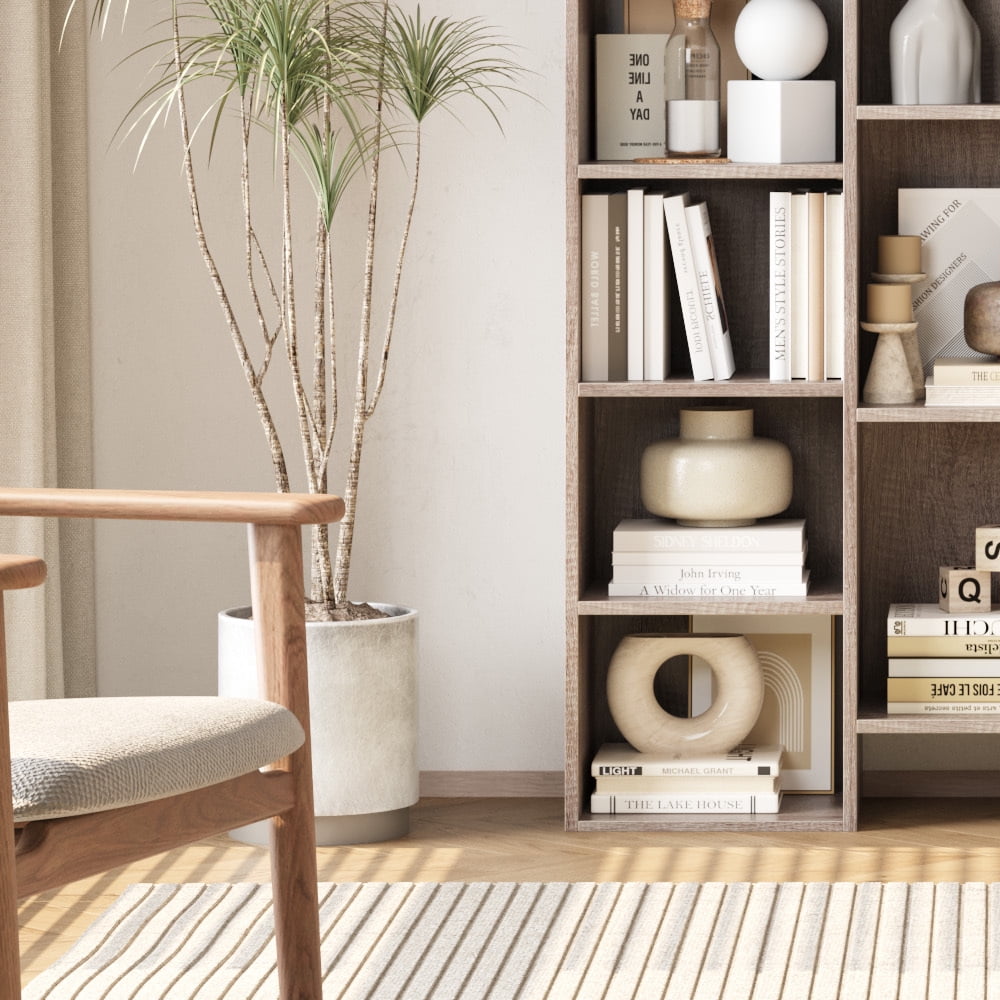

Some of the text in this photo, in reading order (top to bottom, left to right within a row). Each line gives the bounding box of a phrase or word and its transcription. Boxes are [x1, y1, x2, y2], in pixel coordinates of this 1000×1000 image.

[919, 199, 962, 244] AWING FOR
[774, 207, 786, 267] STORIES
[912, 253, 967, 312] SHION DESIGNERS
[774, 270, 786, 314] STYLE
[972, 371, 989, 381] THE
[679, 568, 742, 581] John Irving
[640, 584, 777, 596] A Widow for One Year
[958, 578, 981, 604] Q
[931, 684, 956, 699] CAFÉ
[959, 684, 971, 695] LE
[973, 684, 994, 695] FOIS
[602, 767, 733, 776] LIGHT MICHAEL GRANT
[624, 800, 743, 810] THE LAKE HOUSE
